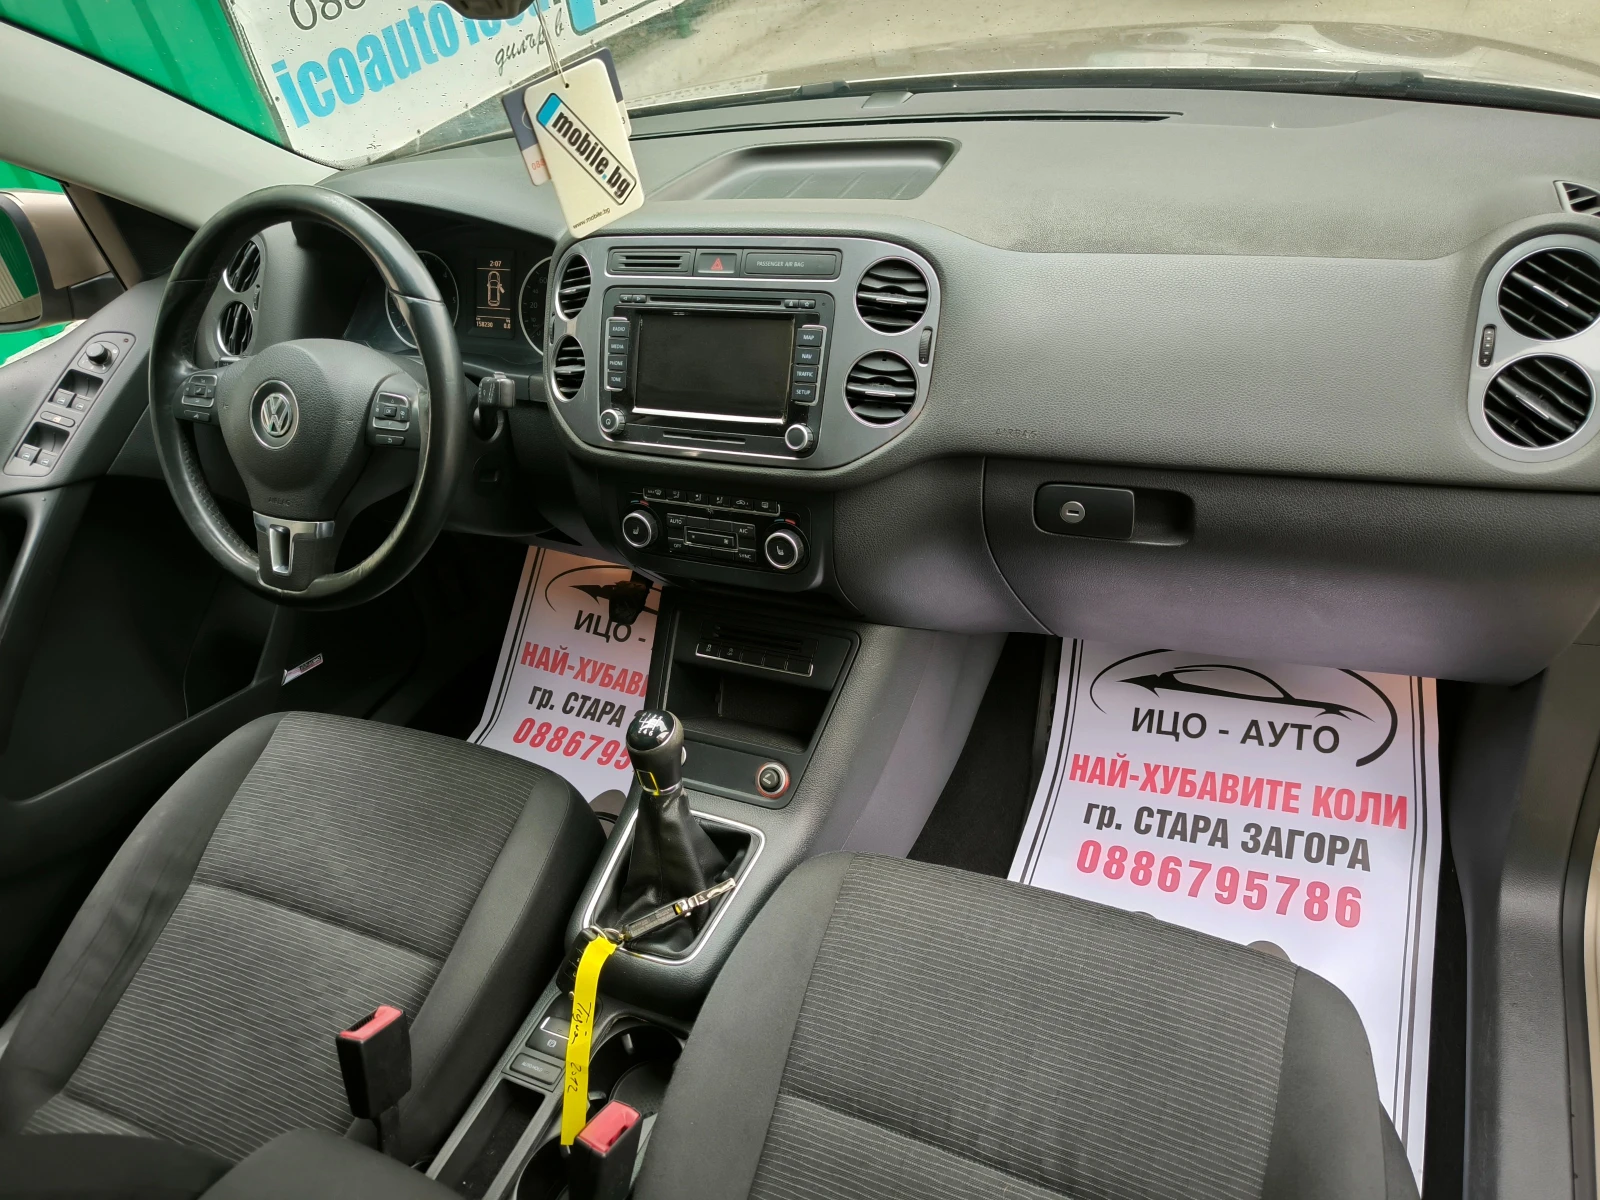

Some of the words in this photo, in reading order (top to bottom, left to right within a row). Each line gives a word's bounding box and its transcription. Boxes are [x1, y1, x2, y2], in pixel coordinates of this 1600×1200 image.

[551, 111, 631, 199] mobile.bg
[572, 207, 611, 230] www.mobile.bg
[574, 609, 632, 643] ИЦО
[527, 685, 555, 711] гр.
[561, 691, 627, 728] СТАРА
[1131, 706, 1208, 742] ИЦО
[1240, 718, 1341, 754] АУТО
[512, 717, 633, 772] 0886795
[1068, 752, 1300, 814] НАЙ-ХУБАВИТЕ
[1312, 785, 1409, 830] КОЛИ
[1082, 802, 1123, 830] гр.
[1133, 806, 1230, 849] СТАРА
[1240, 822, 1372, 872] ЗАГОРА
[1076, 839, 1363, 929] 0886795786
[521, 1061, 533, 1069] AUTO
